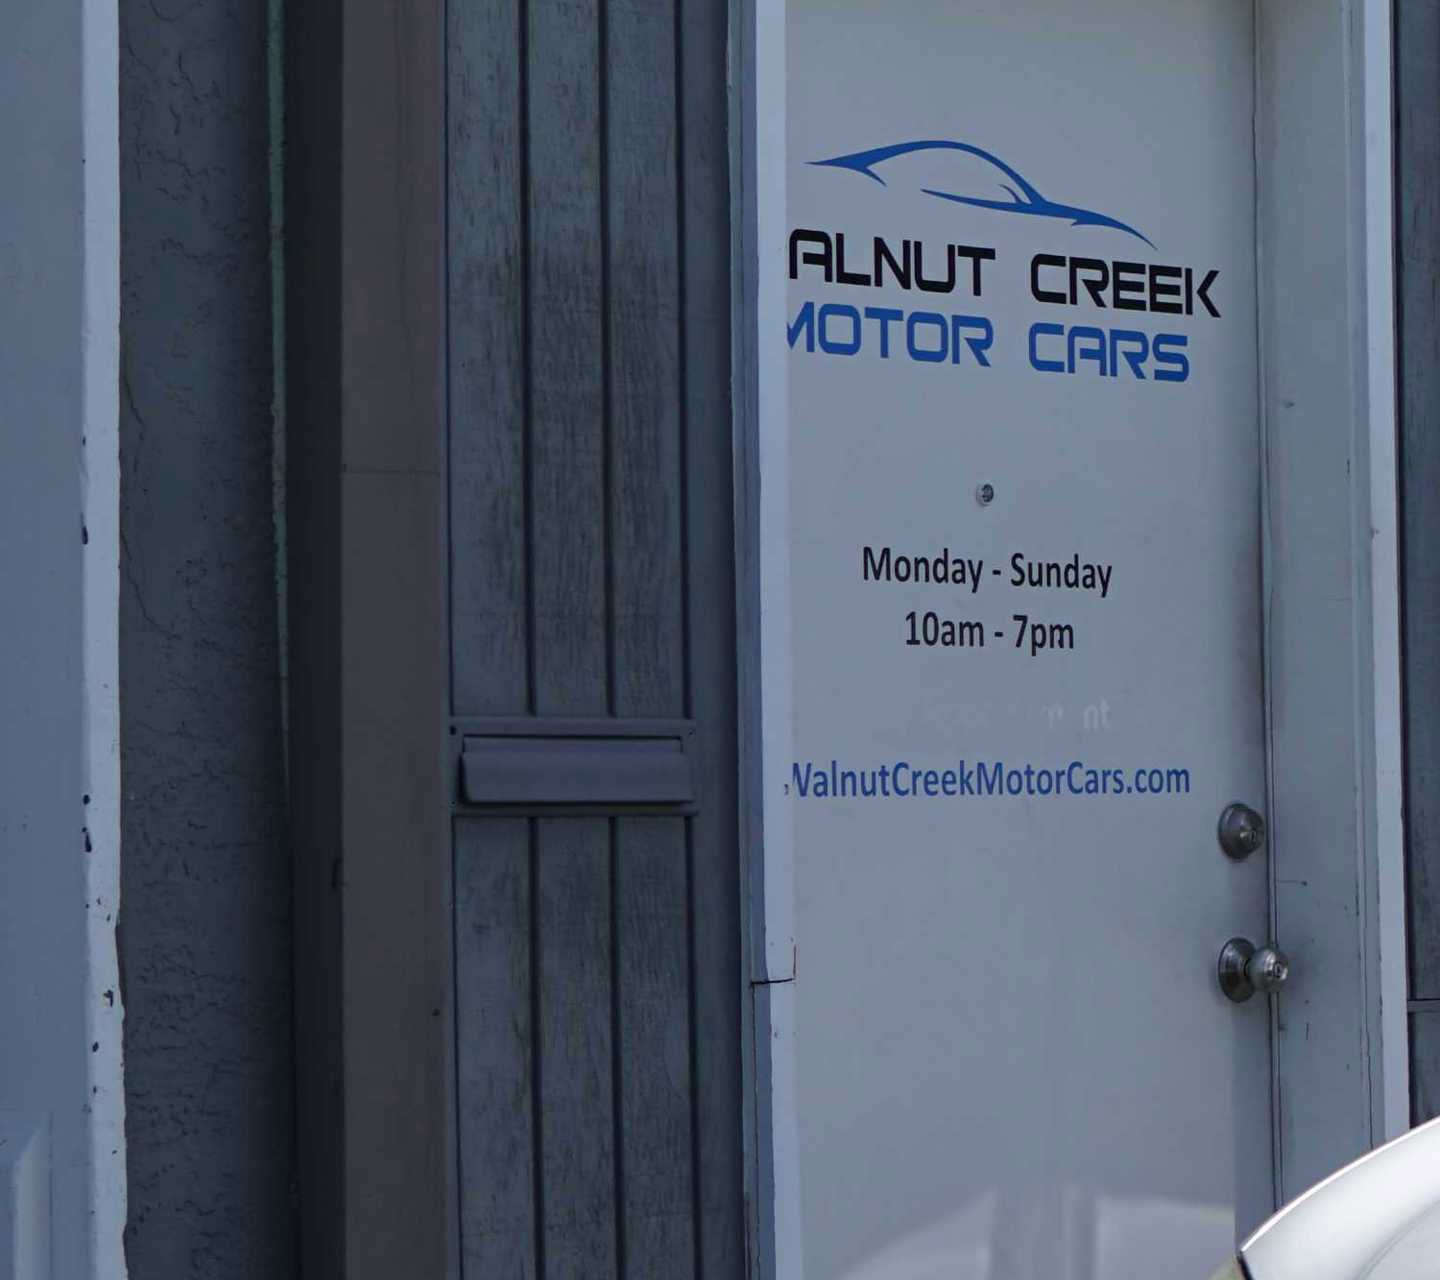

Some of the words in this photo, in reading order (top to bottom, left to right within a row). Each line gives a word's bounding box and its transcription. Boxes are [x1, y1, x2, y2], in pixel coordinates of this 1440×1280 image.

[788, 228, 996, 297] ALNUT
[1030, 253, 1221, 318] CREEK
[1028, 322, 1190, 383] CARS
[863, 546, 983, 594] Monday
[1010, 552, 1113, 598] Sunday
[905, 611, 985, 647] 10am
[1012, 614, 1075, 657] 7pm
